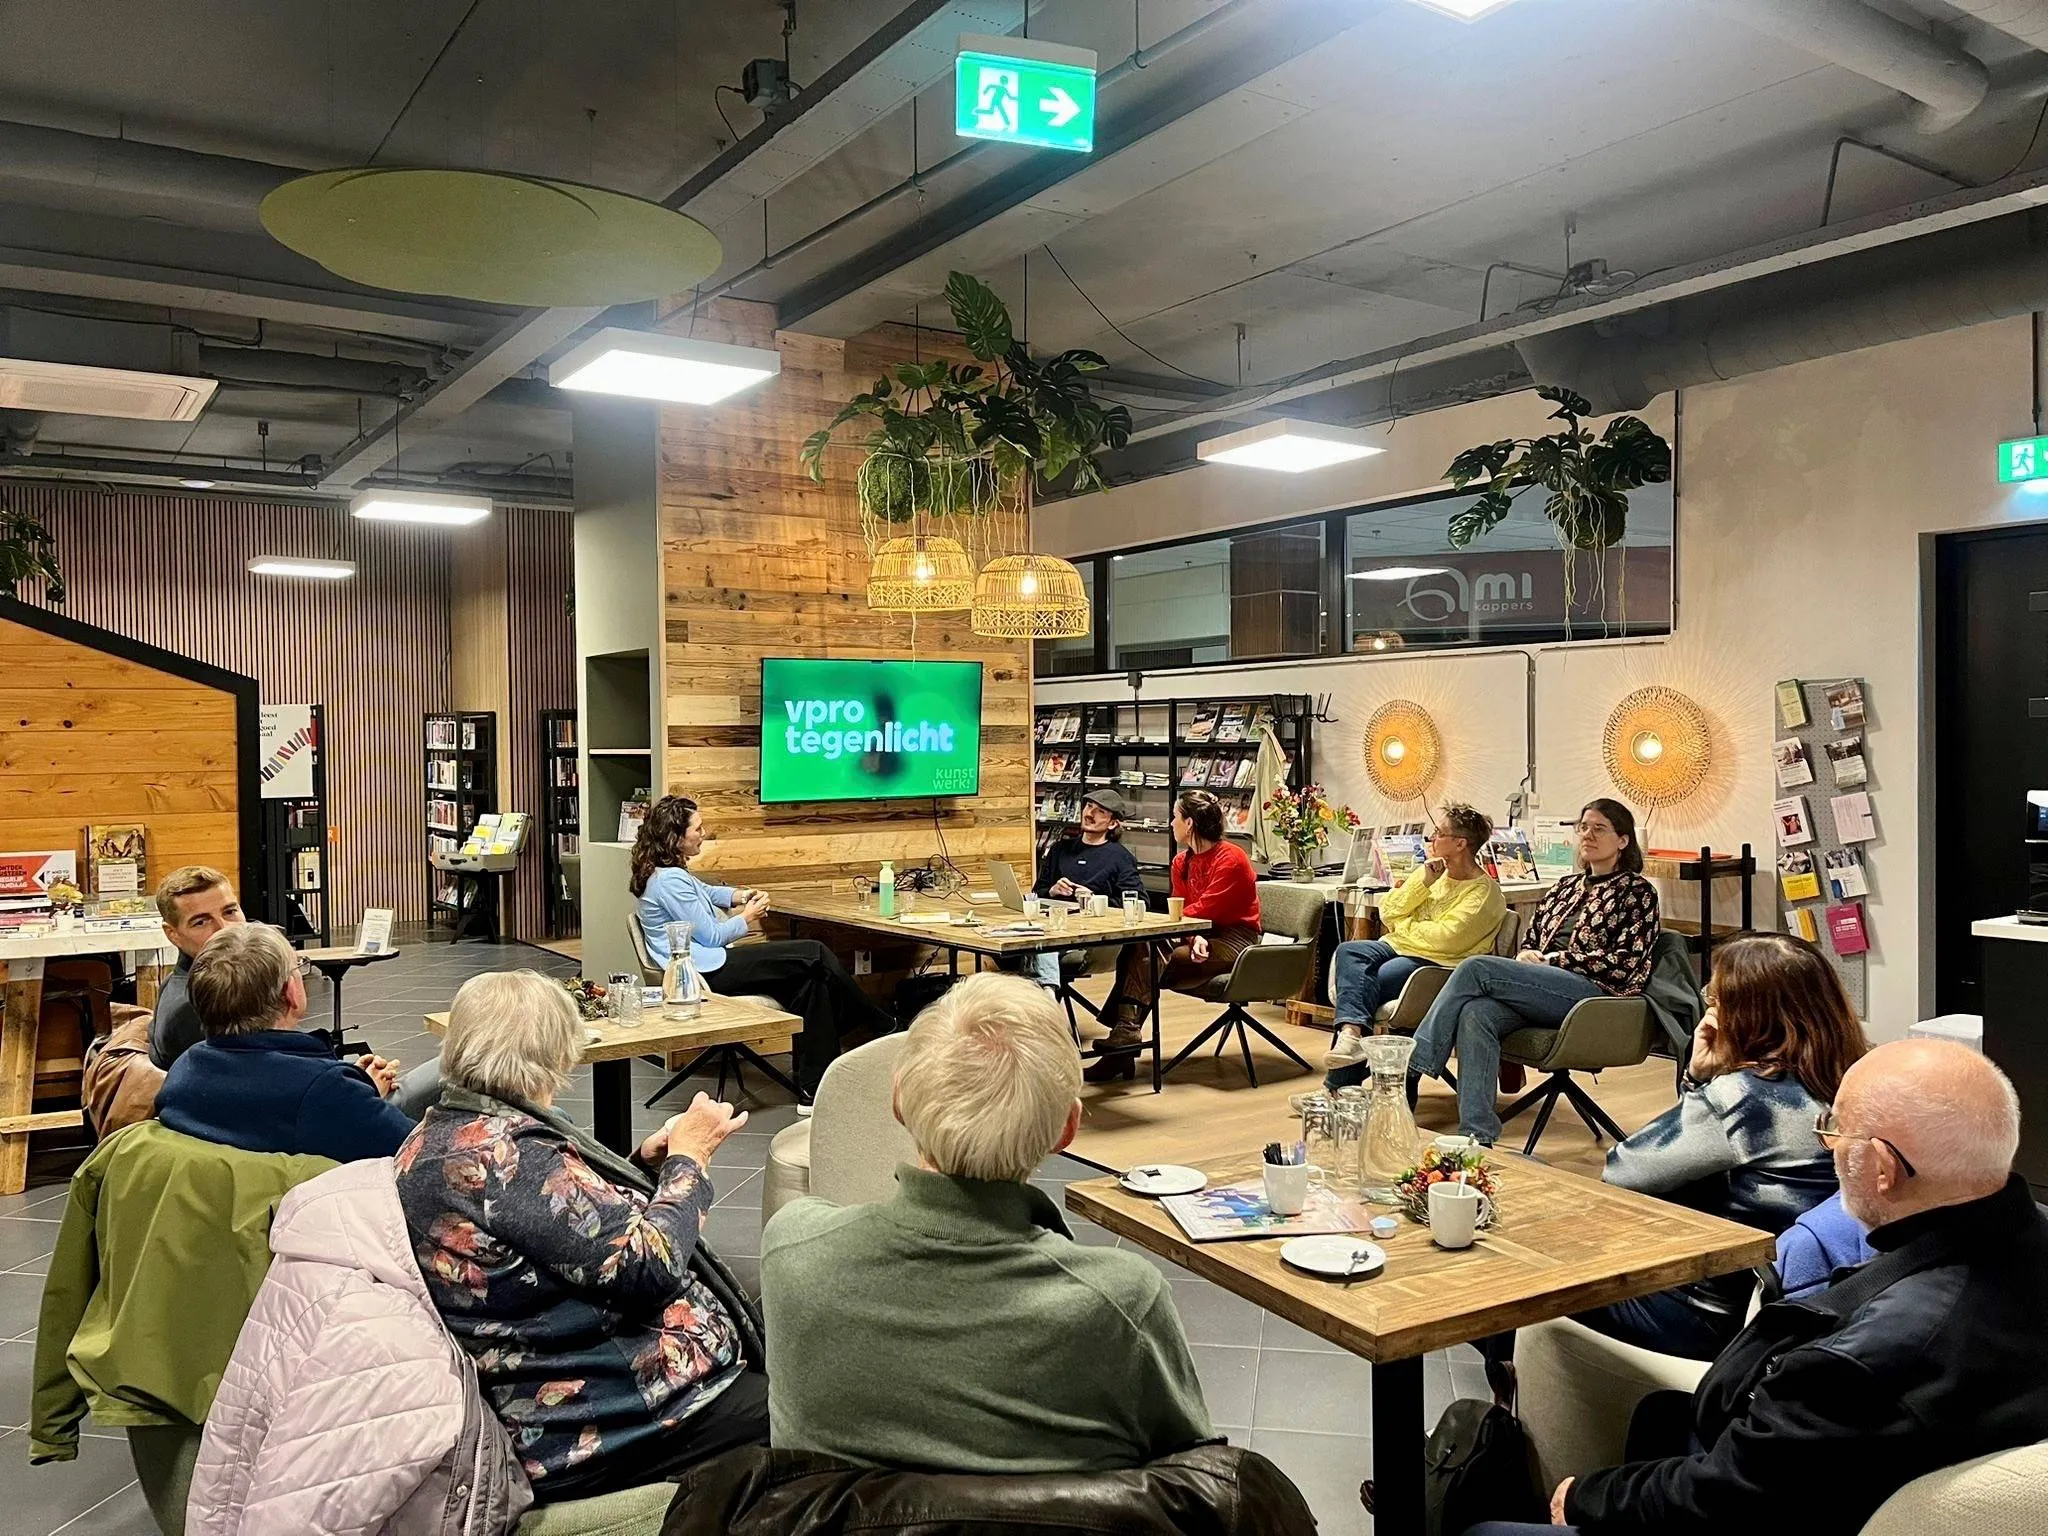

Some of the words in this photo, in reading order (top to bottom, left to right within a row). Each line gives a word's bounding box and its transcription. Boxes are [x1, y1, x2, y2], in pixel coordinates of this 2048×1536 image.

[1475, 601, 1533, 613] kappers
[784, 700, 865, 729] vpro
[785, 720, 954, 760] tegenlicht
